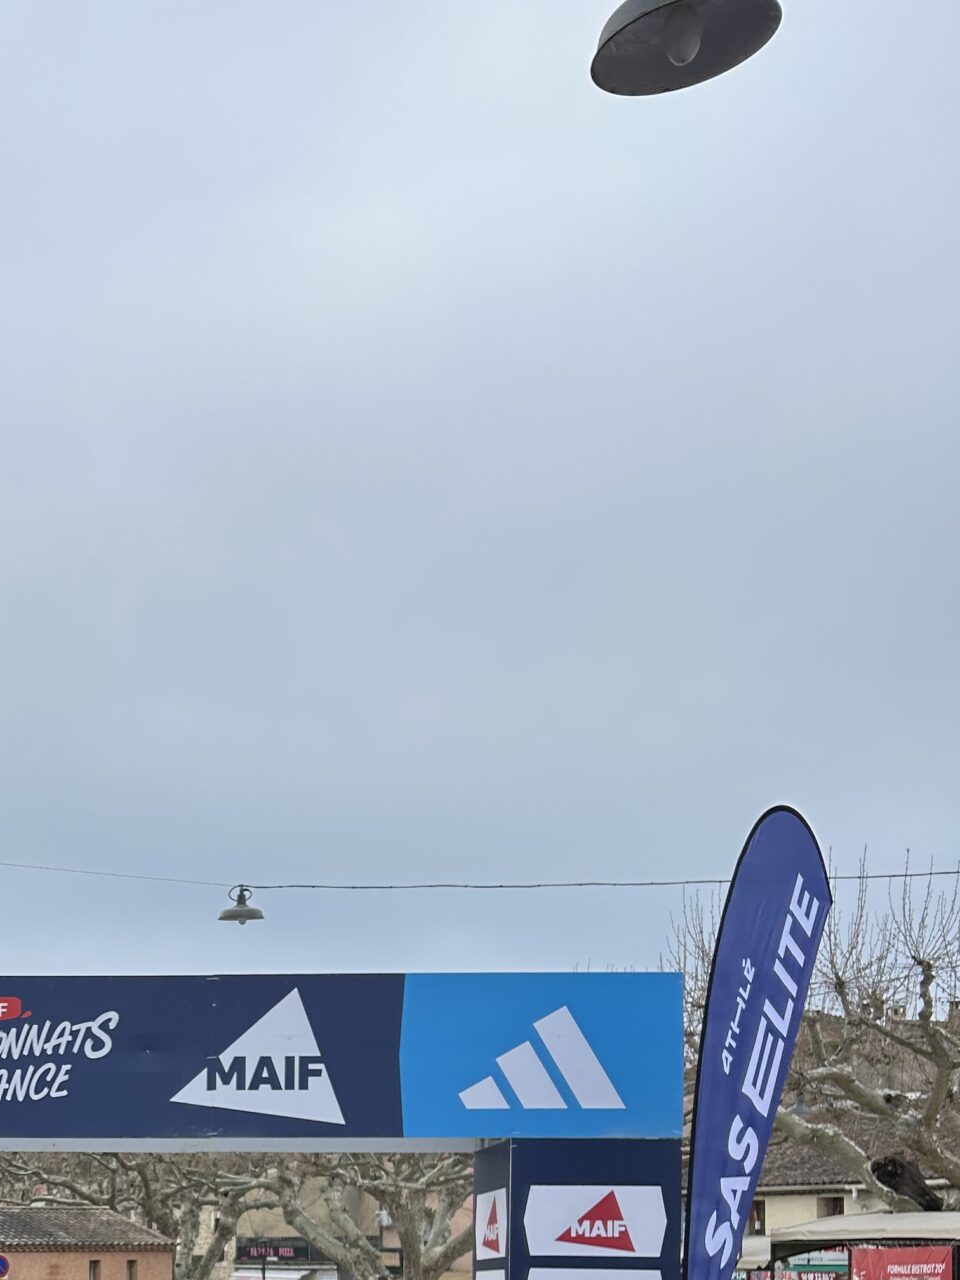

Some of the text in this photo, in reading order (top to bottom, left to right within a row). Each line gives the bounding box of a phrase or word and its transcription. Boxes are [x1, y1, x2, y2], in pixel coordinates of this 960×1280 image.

[721, 957, 756, 1076] ATHLÉ
[205, 1055, 324, 1091] MAIF
[704, 872, 820, 1269] SAS ELITE
[570, 1219, 626, 1238] MAIF
